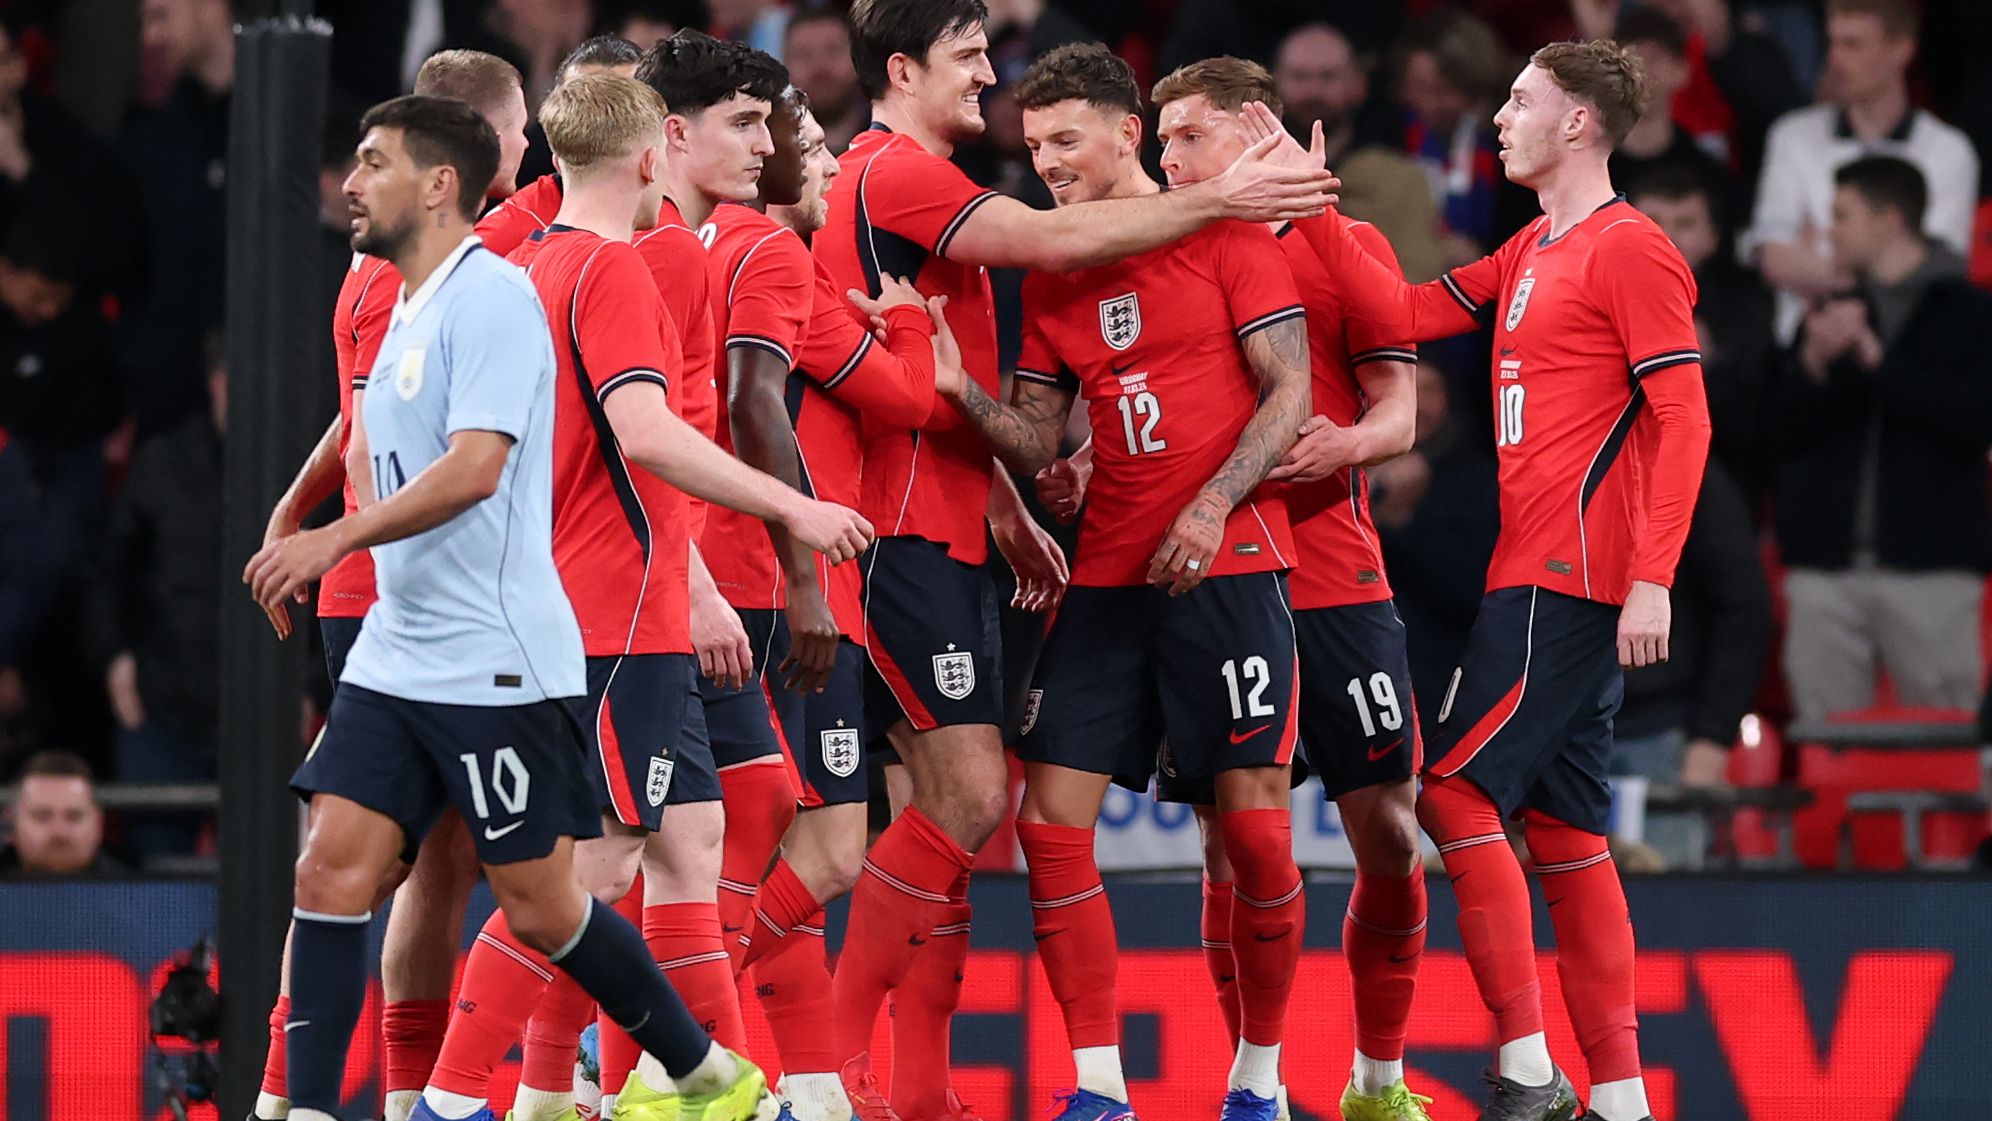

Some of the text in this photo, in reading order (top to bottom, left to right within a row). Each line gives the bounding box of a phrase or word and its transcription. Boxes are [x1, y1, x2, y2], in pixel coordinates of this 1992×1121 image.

[1117, 391, 1167, 456] 12
[1498, 384, 1525, 447] 10
[1221, 655, 1276, 720] 12
[1346, 671, 1404, 737] 19
[459, 746, 531, 819] 10
